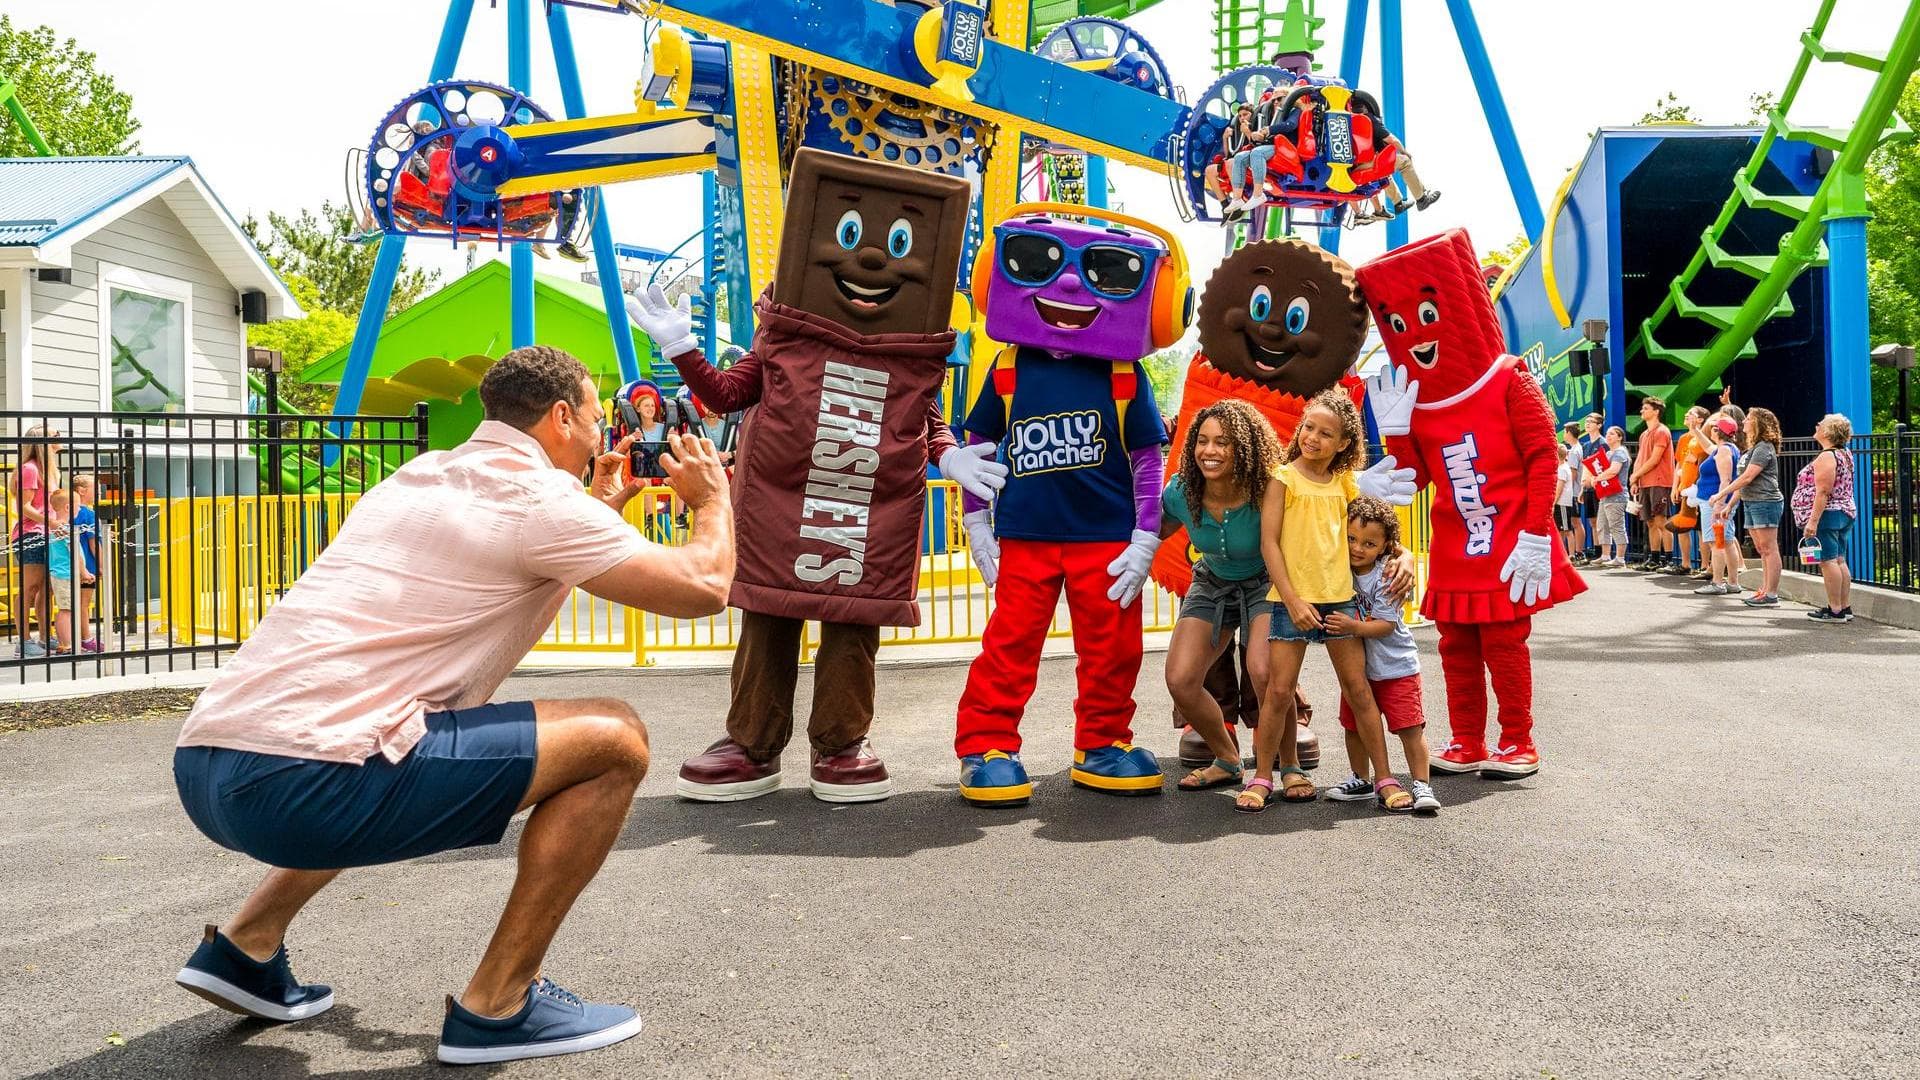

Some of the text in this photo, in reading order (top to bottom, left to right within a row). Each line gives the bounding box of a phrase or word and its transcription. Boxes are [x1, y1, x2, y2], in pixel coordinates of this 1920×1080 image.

[953, 14, 970, 58] JOLLY
[966, 15, 978, 59] rancher
[1330, 121, 1344, 159] JOLLY
[1012, 415, 1096, 455] JOLLY
[794, 361, 890, 586] HERSHEY'S
[1016, 443, 1103, 473] rancher
[1441, 432, 1500, 556] Twizzlers
